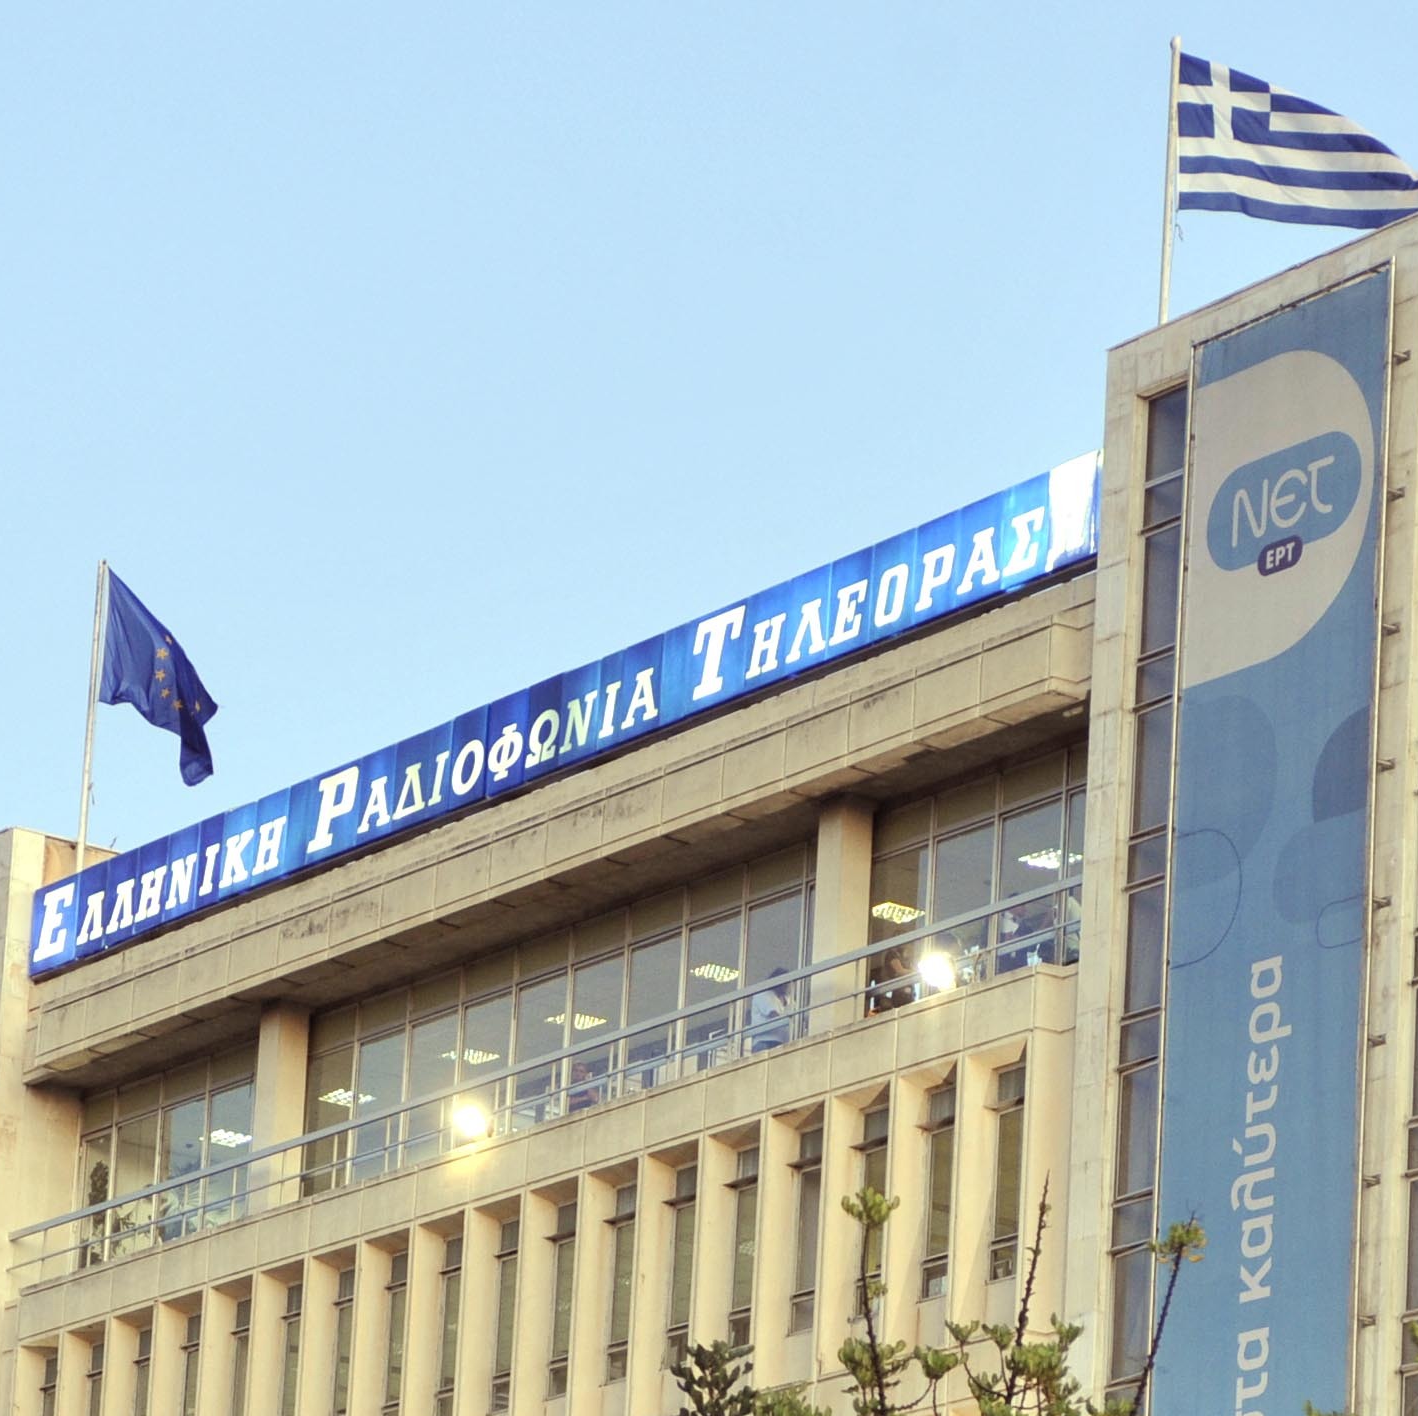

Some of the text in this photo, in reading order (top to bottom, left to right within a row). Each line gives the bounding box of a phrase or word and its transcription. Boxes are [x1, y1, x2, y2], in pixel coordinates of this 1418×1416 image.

[33, 816, 287, 962] ΕΛΛΗΝΙΚΗ
[307, 667, 659, 853] ΡΑΔΙΟΦΩΝΙΑ
[1231, 955, 1292, 1305] καλύτερα
